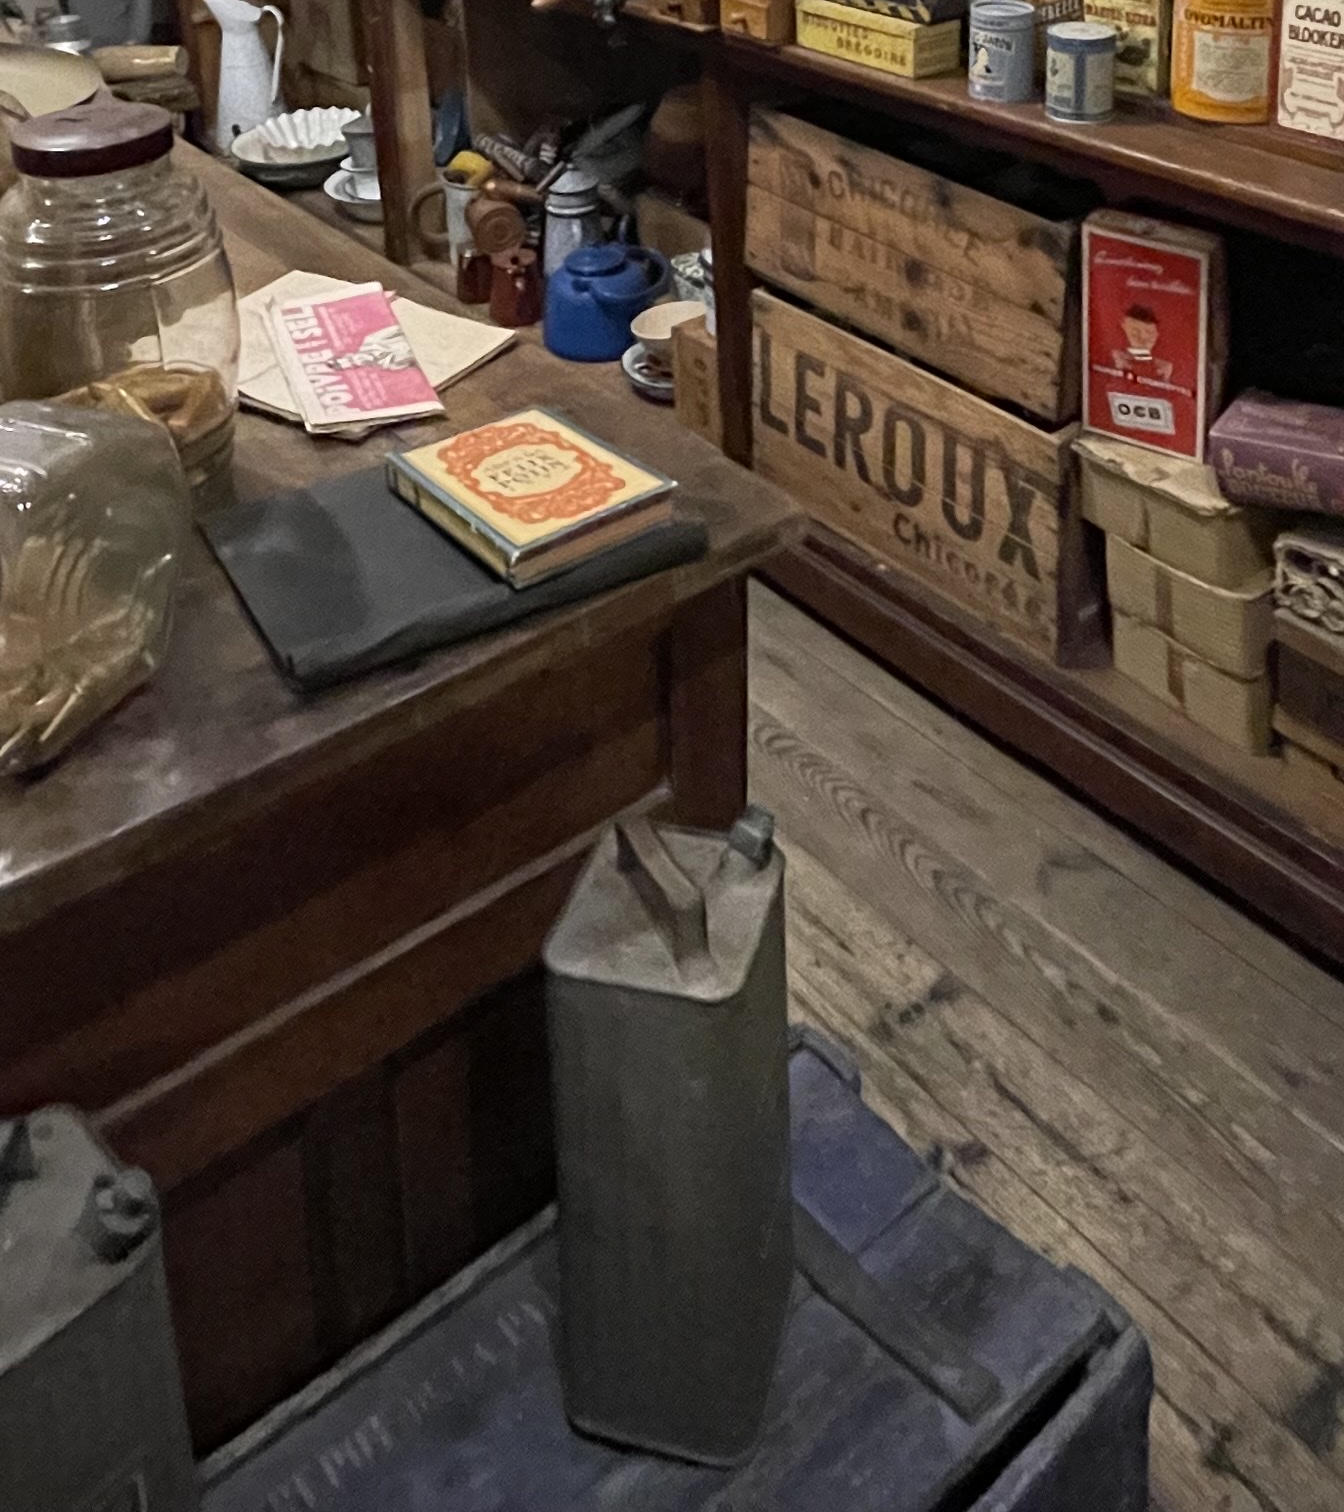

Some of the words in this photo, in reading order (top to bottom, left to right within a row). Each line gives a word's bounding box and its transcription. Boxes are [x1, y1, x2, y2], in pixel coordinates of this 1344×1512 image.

[1294, 3, 1342, 29] CACAO
[283, 304, 325, 340] SEL
[302, 347, 362, 417] POIVRE
[1117, 400, 1163, 422] OCB
[757, 326, 1043, 582] LEROUX
